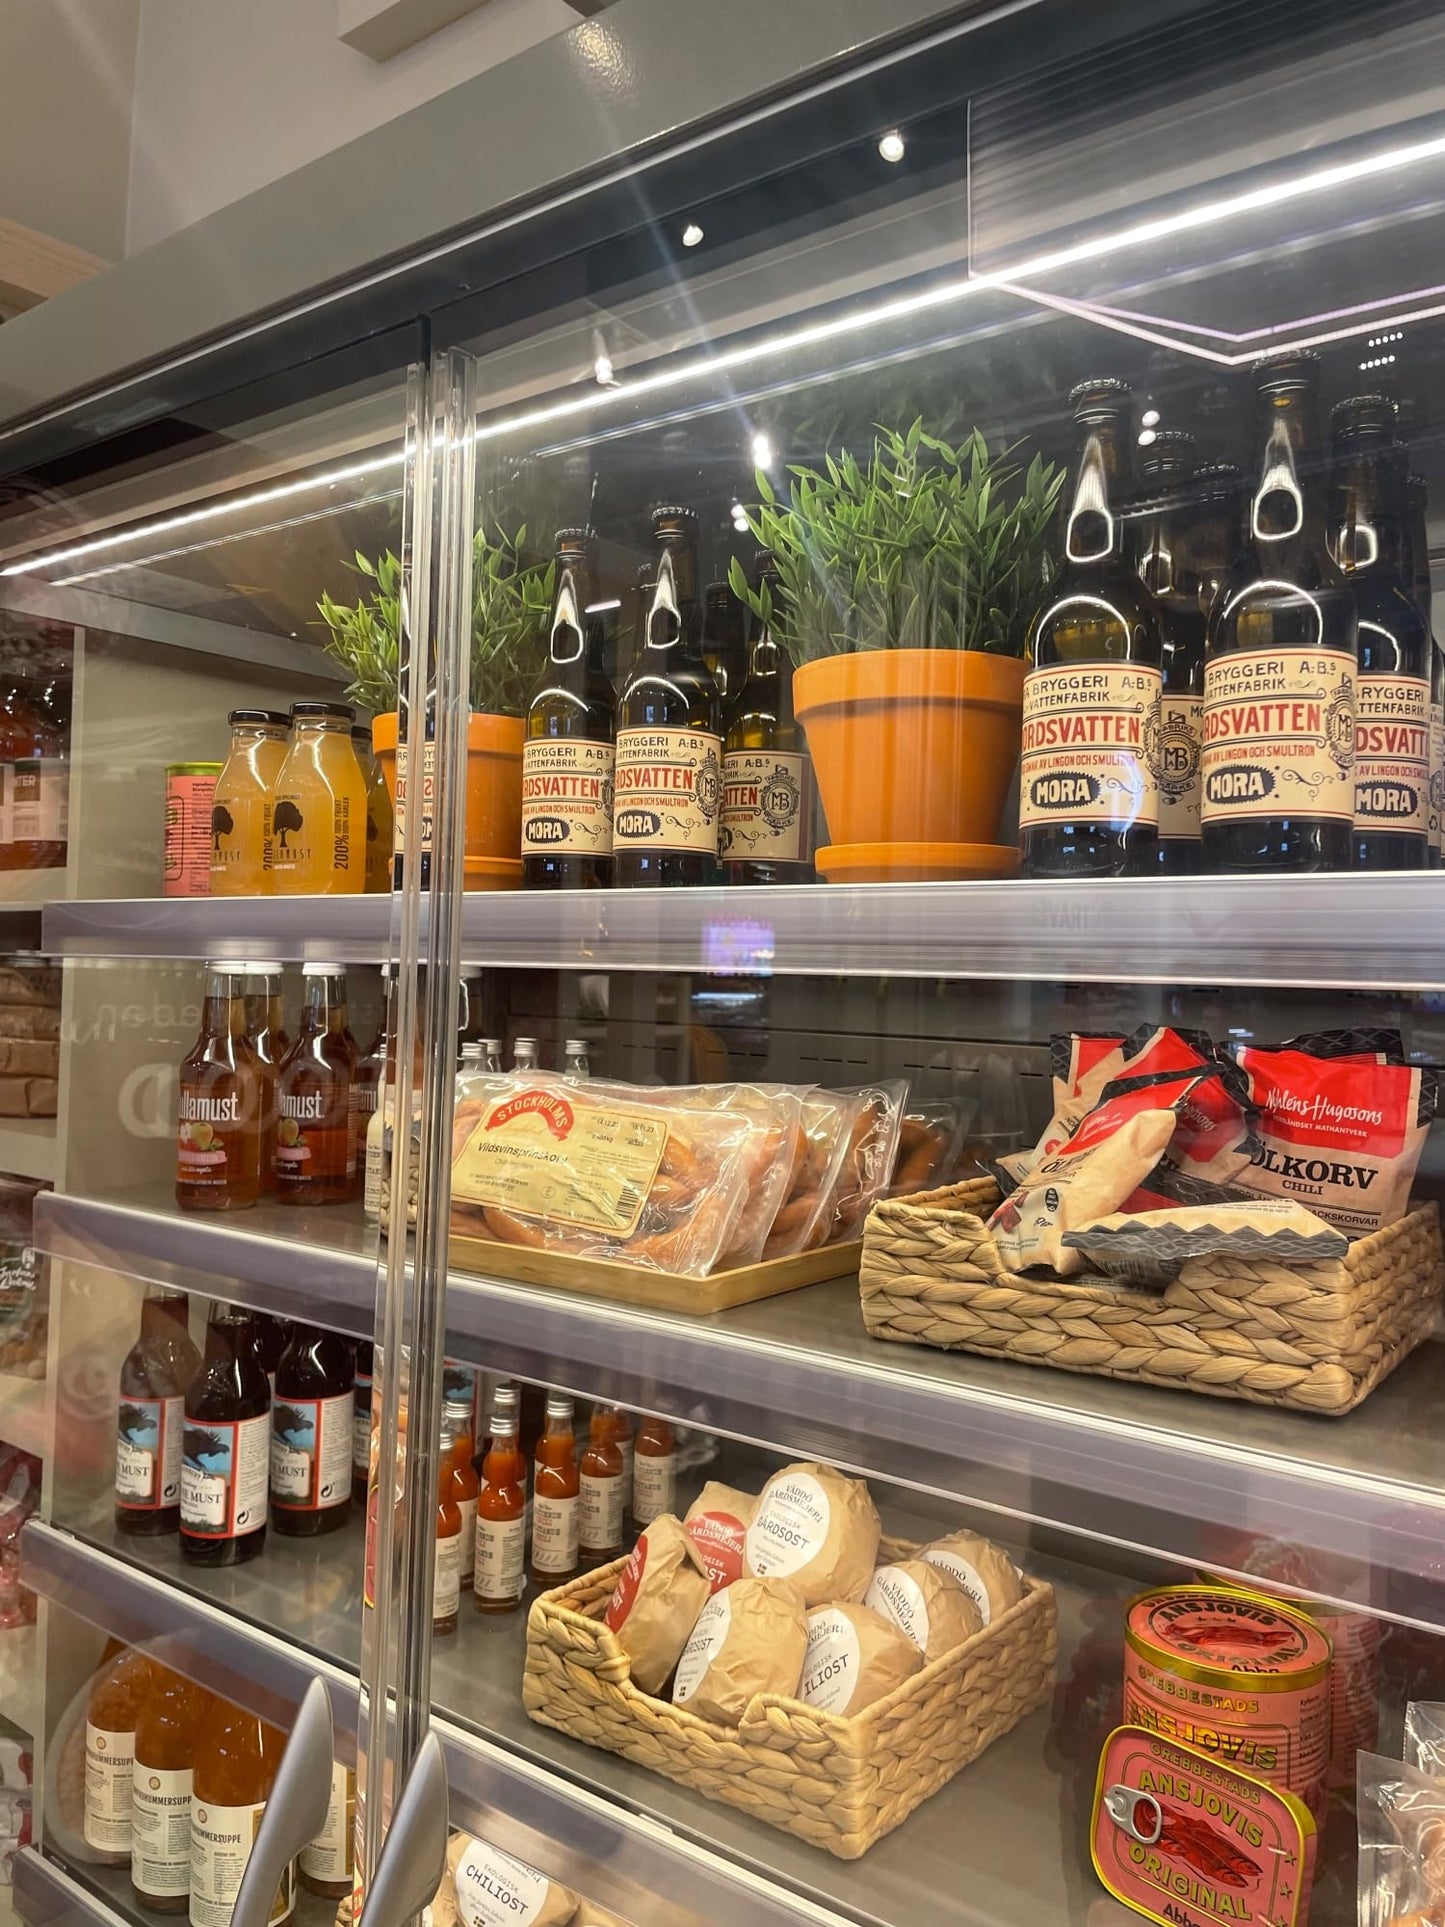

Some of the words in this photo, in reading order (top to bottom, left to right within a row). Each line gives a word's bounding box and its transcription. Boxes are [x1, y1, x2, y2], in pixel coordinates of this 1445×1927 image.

[1033, 675, 1108, 695] BRYGGERI
[1208, 661, 1284, 686] BRYGGERI
[1357, 686, 1424, 702] RYGGERI
[1357, 702, 1425, 717] TTENFABRIK
[526, 748, 576, 759] BRYGGERI
[618, 736, 668, 749] BRYGGERI
[1266, 744, 1315, 757] SMULTRON
[1048, 756, 1074, 768] LINGON
[1076, 755, 1091, 766] OCH
[1036, 779, 1092, 804] MORA
[1210, 772, 1266, 800] MORA
[1356, 788, 1412, 812] MORA
[528, 822, 563, 840] MORA
[619, 816, 654, 834] MORA
[334, 834, 350, 870] 200%
[498, 1096, 568, 1128] STOCKHOLMS
[1303, 1094, 1382, 1126] Hugosons
[1314, 1123, 1368, 1138] MATHANTVERK
[1282, 1180, 1324, 1196] CHILI
[122, 1464, 149, 1477] MUST
[190, 1492, 222, 1504] MUST
[786, 1484, 813, 1503] VÄDDÖ
[891, 1582, 915, 1620] VÄDDÖ
[1160, 1602, 1278, 1626] ANSJOVIS
[1176, 1642, 1302, 1666] ORIGINAL
[1138, 1664, 1259, 1713] GREBBESTADS
[1150, 1742, 1260, 1804] GREBBESTADS
[1138, 1769, 1264, 1848] ANSJOVIS
[466, 1864, 529, 1916] CHILIOST
[1128, 1842, 1253, 1921] ORIGINAL
